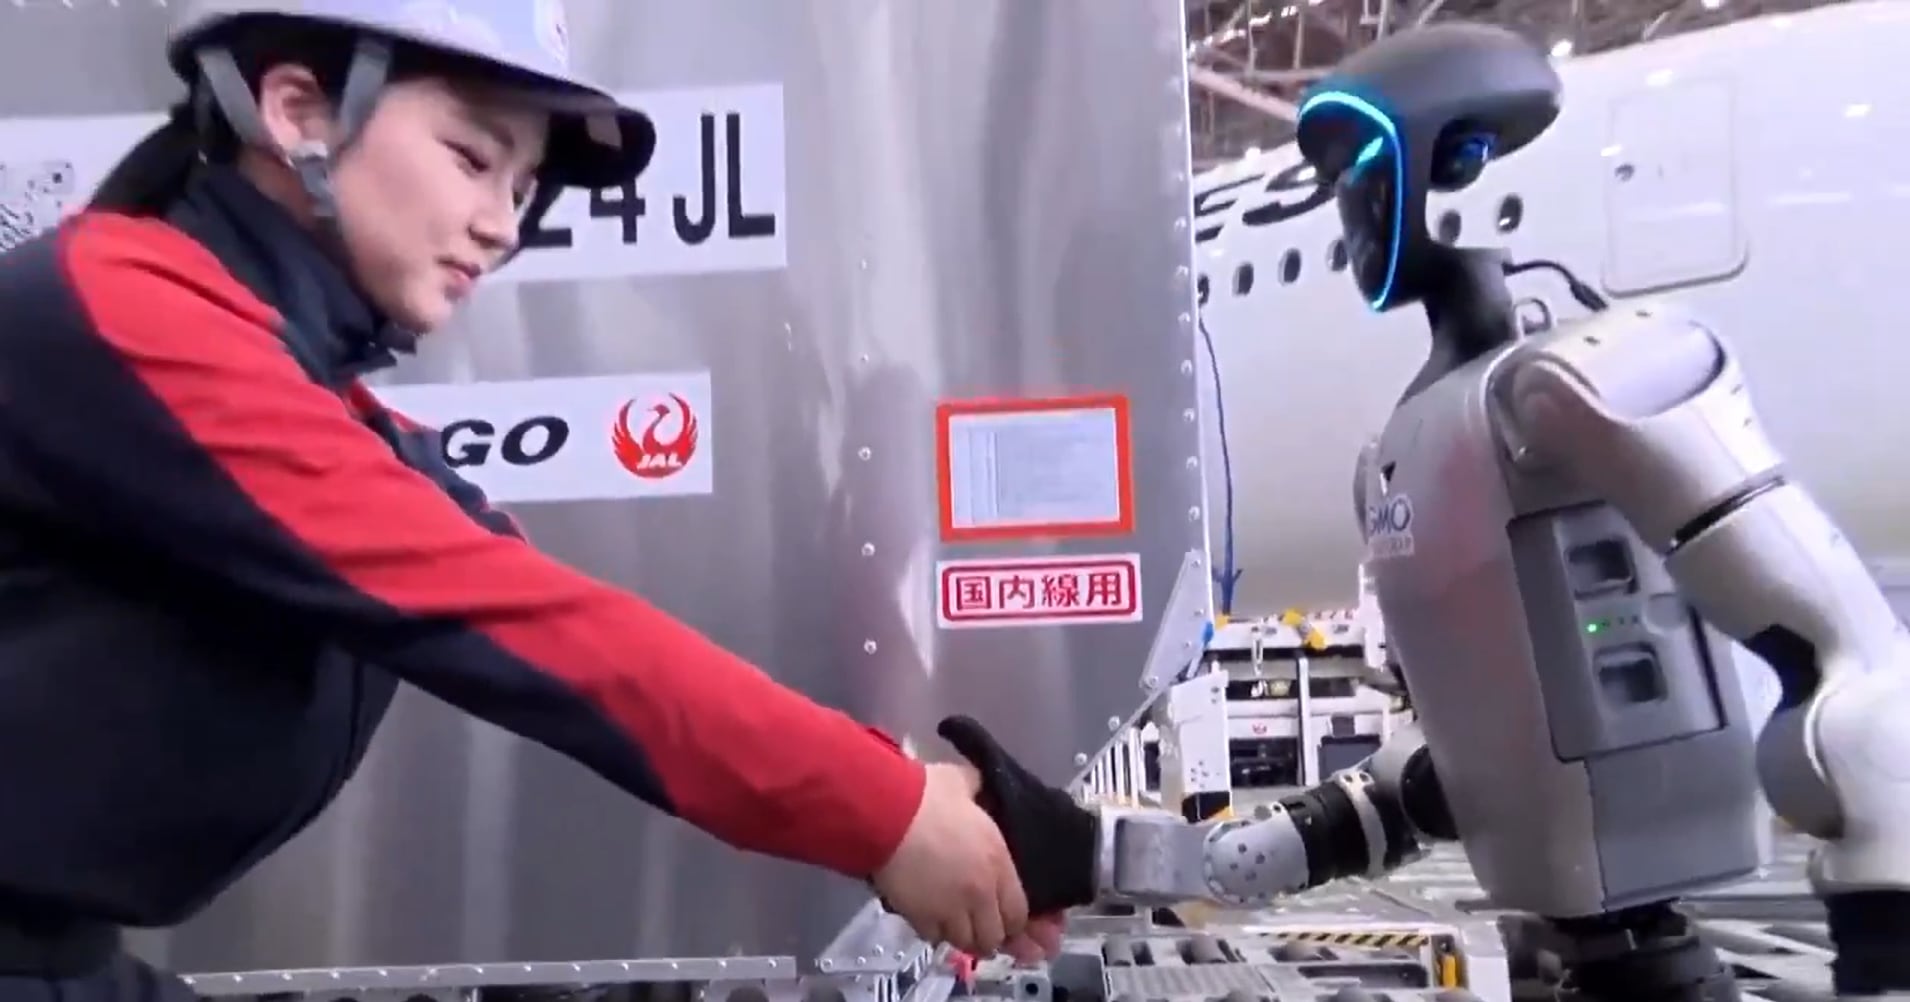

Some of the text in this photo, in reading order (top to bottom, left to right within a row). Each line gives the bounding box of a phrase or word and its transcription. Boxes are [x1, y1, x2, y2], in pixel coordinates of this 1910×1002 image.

[673, 113, 775, 245] JL
[441, 416, 569, 468] GO
[635, 453, 682, 470] JAL
[956, 573, 1122, 611] 国内線用
